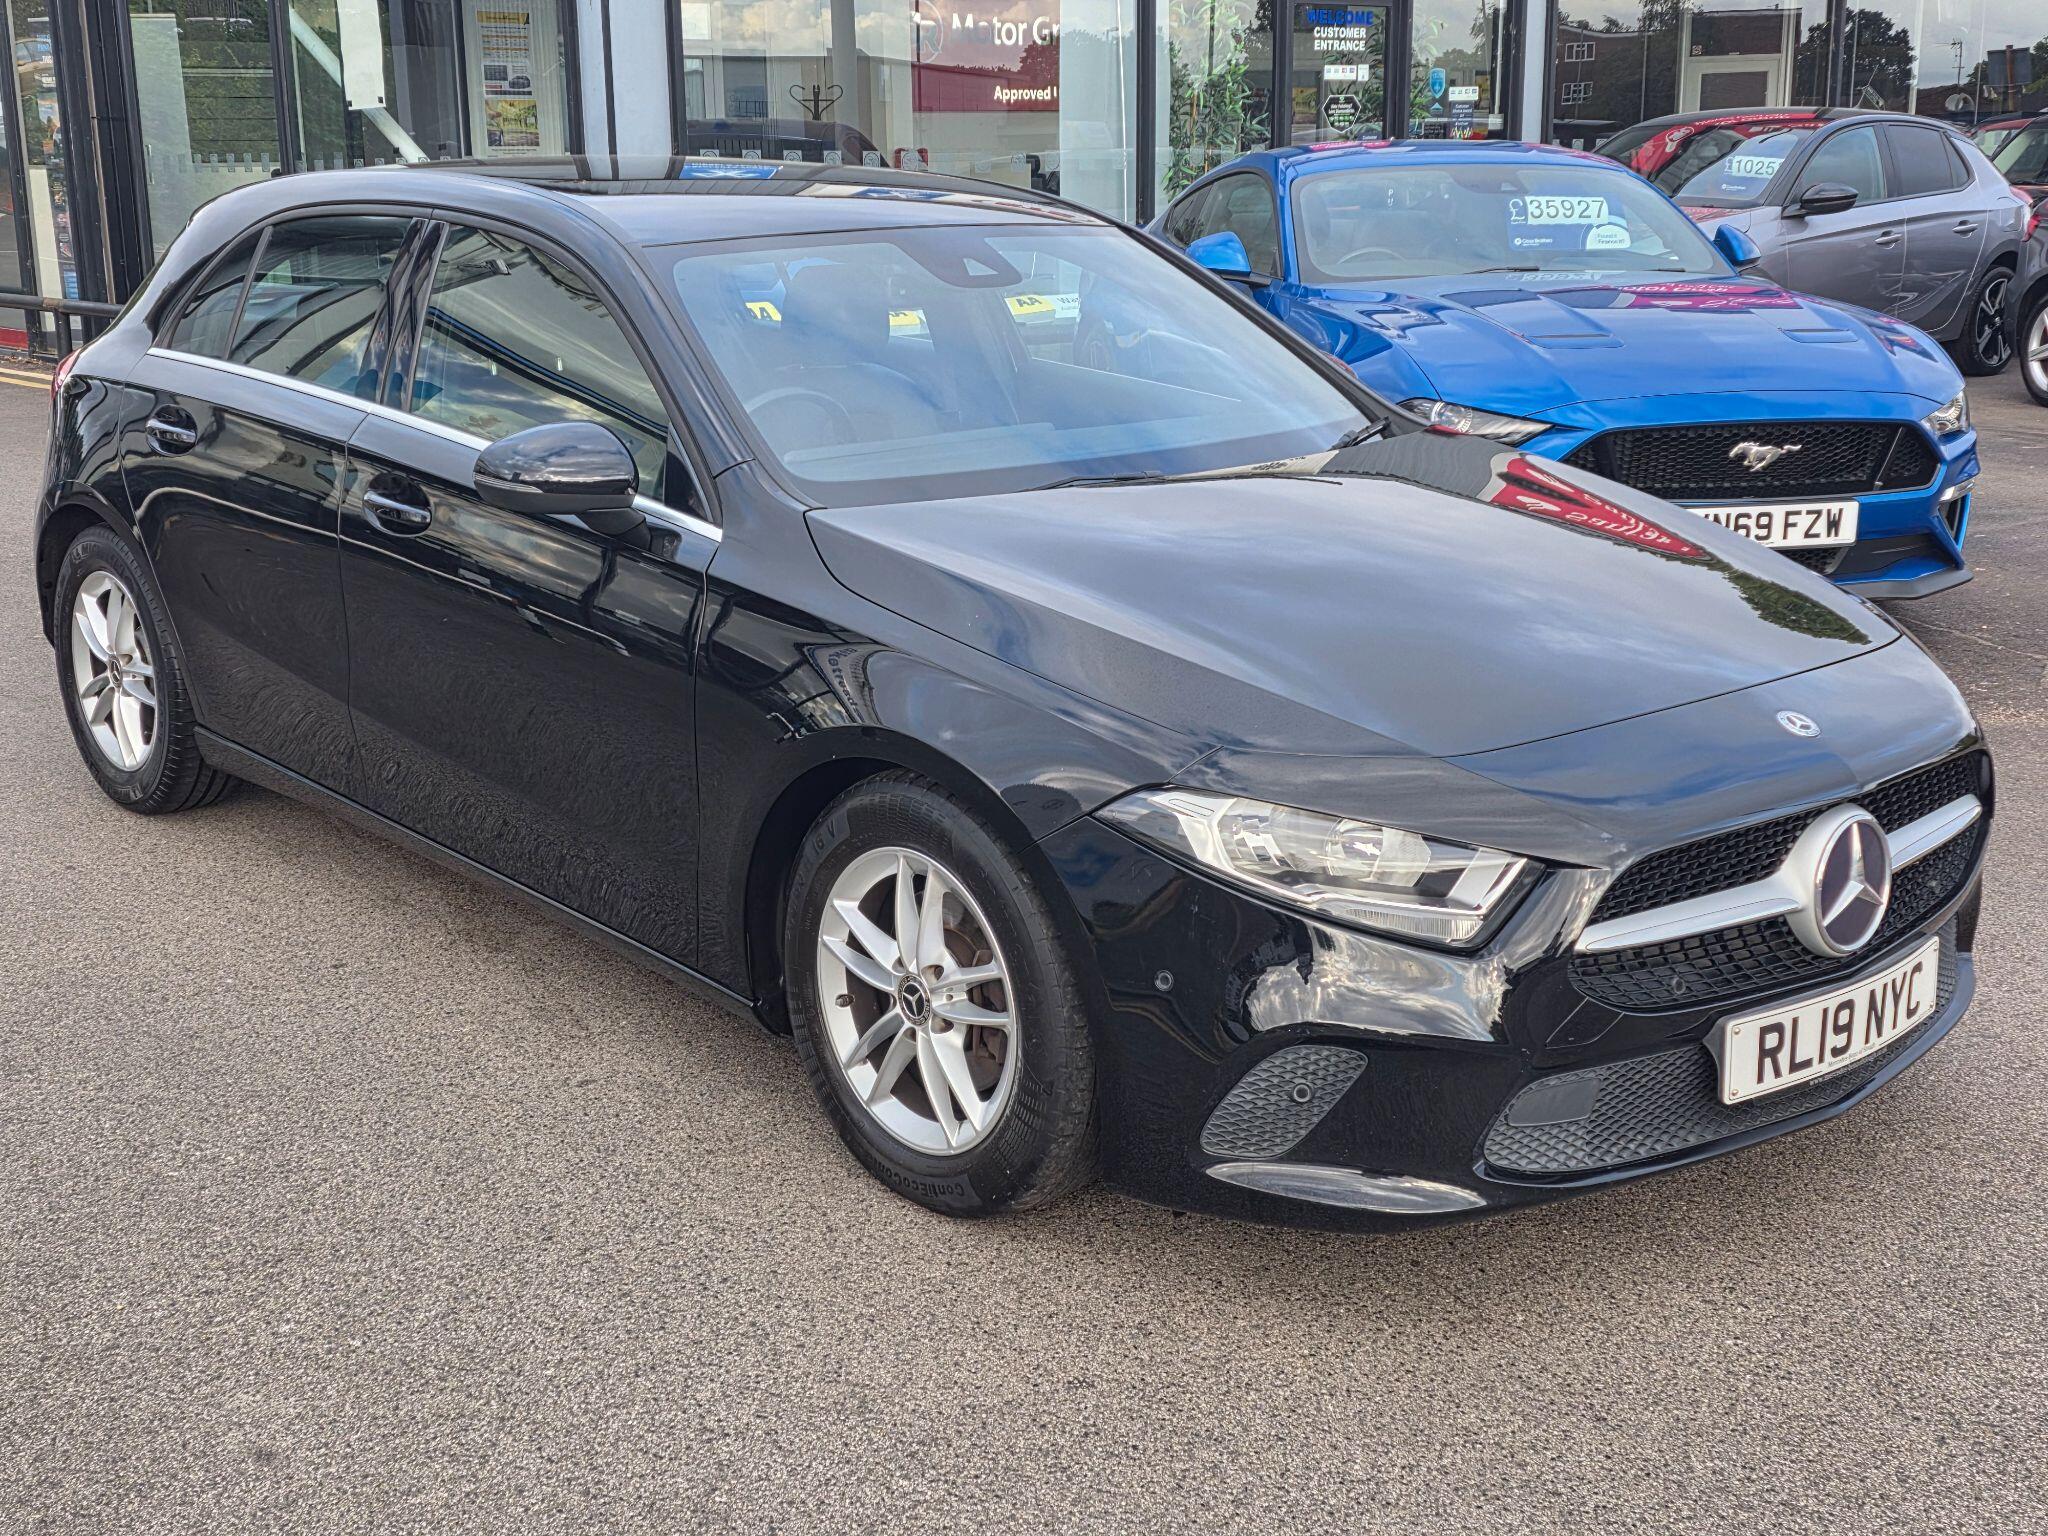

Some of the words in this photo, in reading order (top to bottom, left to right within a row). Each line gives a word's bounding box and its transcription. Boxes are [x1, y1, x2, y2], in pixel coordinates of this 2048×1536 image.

[1307, 9, 1374, 25] WELCOME
[952, 13, 1027, 46] Motor
[1314, 27, 1366, 38] CUSTOMER
[1314, 41, 1365, 51] ENTRANCE
[994, 86, 1051, 103] Approved
[1782, 507, 1844, 541] FZW
[1756, 998, 1857, 1085] RL19
[1864, 961, 1924, 1045] NYC
